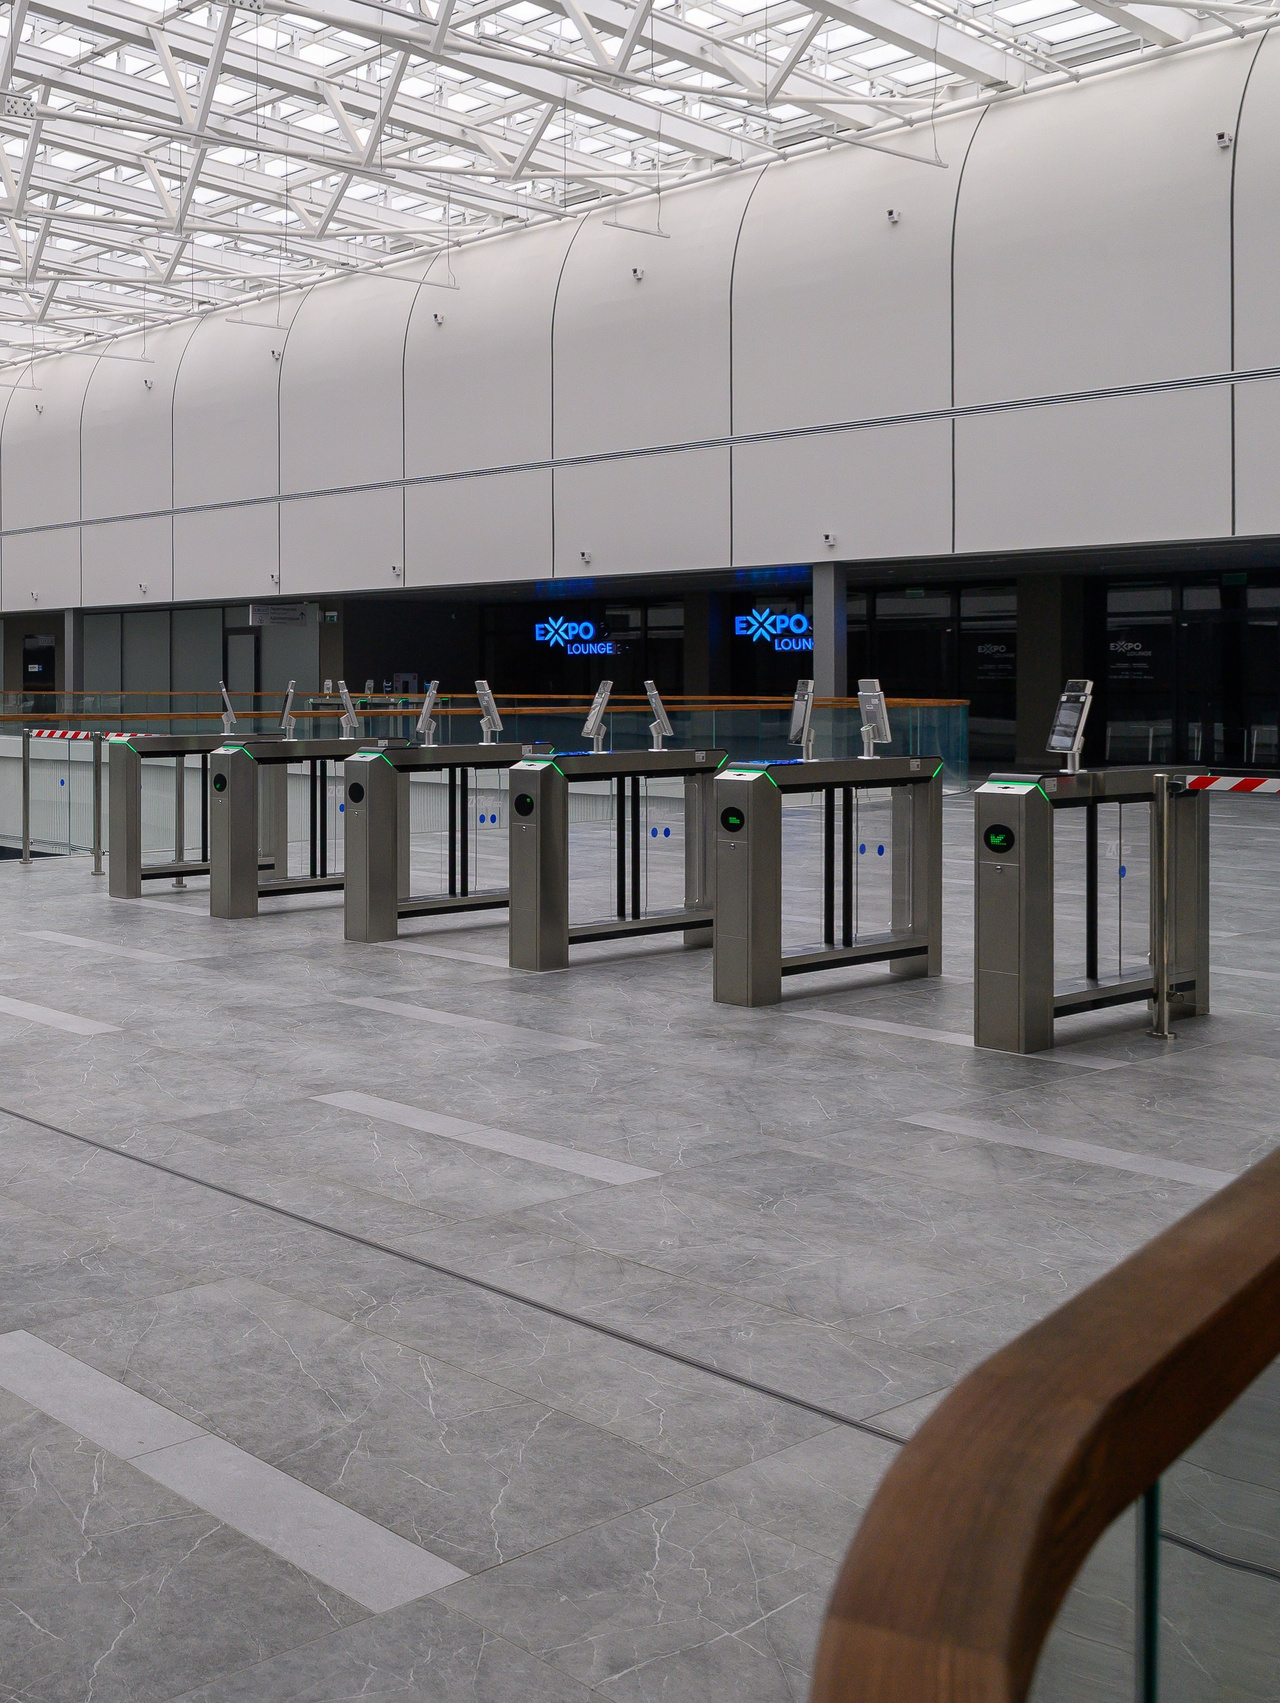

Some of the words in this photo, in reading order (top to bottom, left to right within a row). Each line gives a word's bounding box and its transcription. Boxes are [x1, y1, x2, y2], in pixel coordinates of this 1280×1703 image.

[735, 608, 808, 641] EXPO
[535, 616, 595, 647] EXPO
[567, 643, 613, 654] LOUNGE
[775, 638, 814, 650] LOUN
[978, 643, 1006, 655] EXPO
[1109, 641, 1142, 653] EXPO
